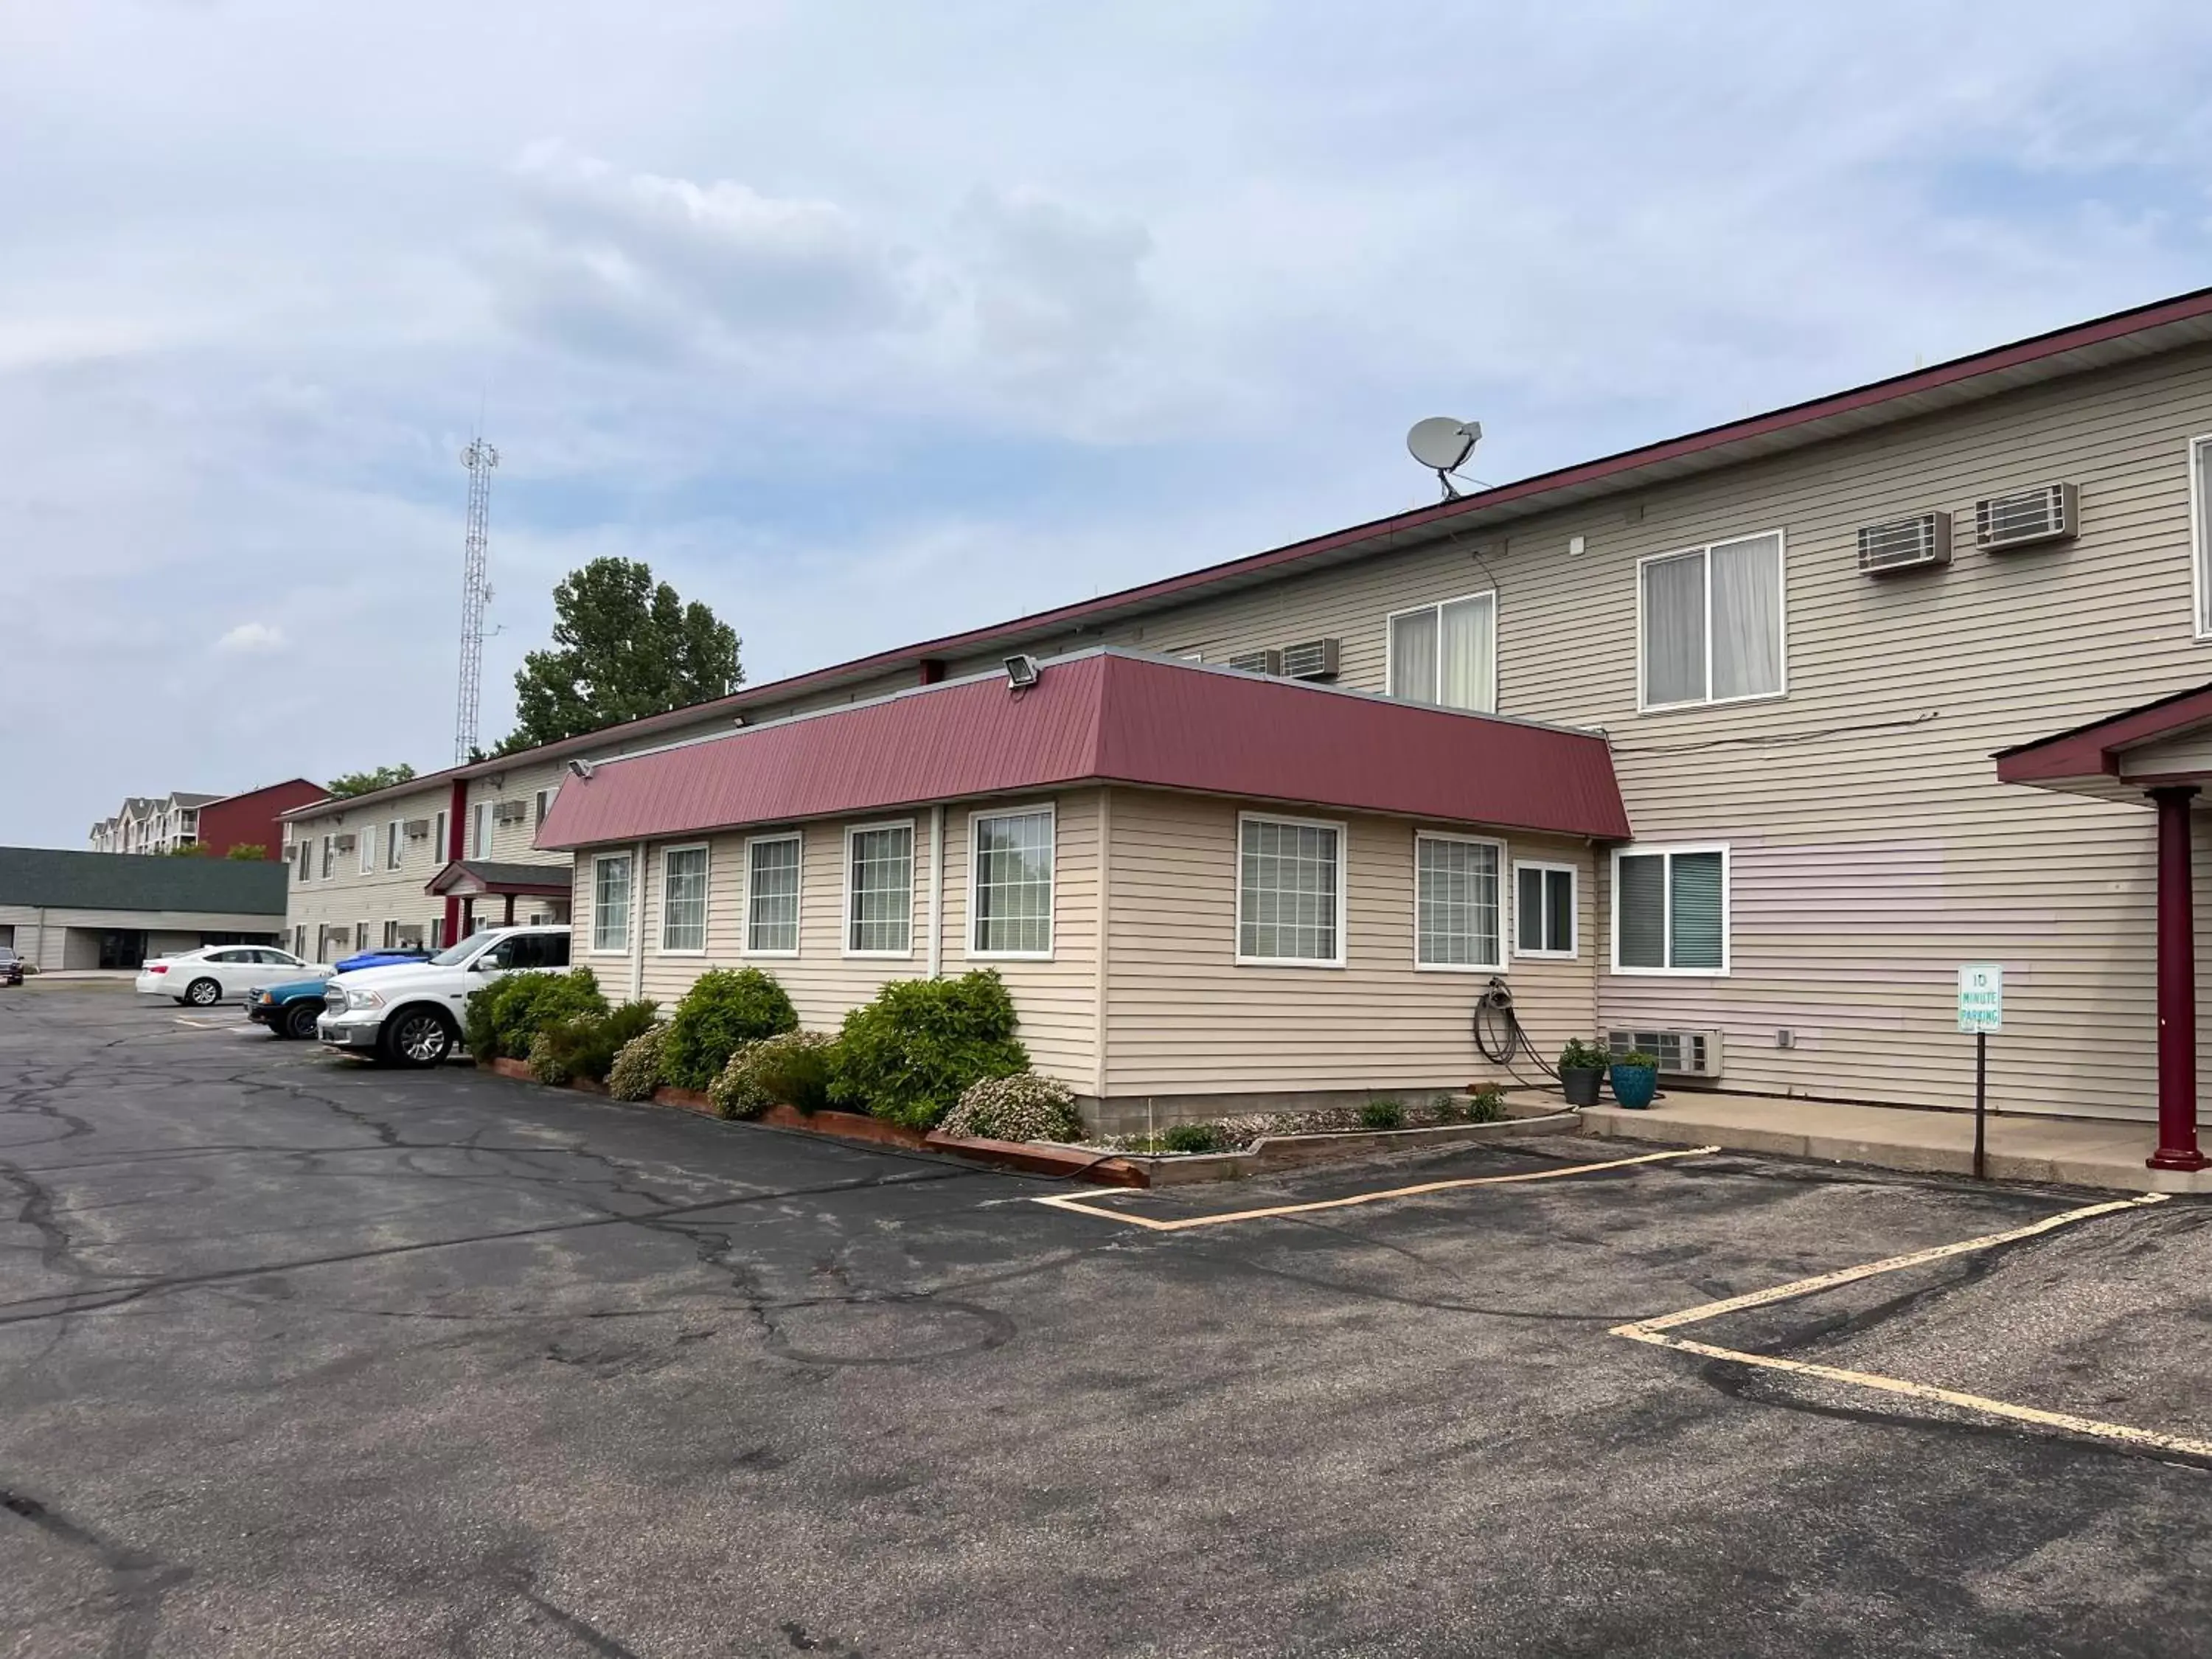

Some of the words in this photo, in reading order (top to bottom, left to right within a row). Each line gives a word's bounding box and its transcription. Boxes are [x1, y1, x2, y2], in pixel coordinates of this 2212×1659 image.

[1974, 974, 1987, 987] 10
[1963, 992, 1997, 1004] MINUTE
[1961, 1009, 1997, 1023] PARKING
